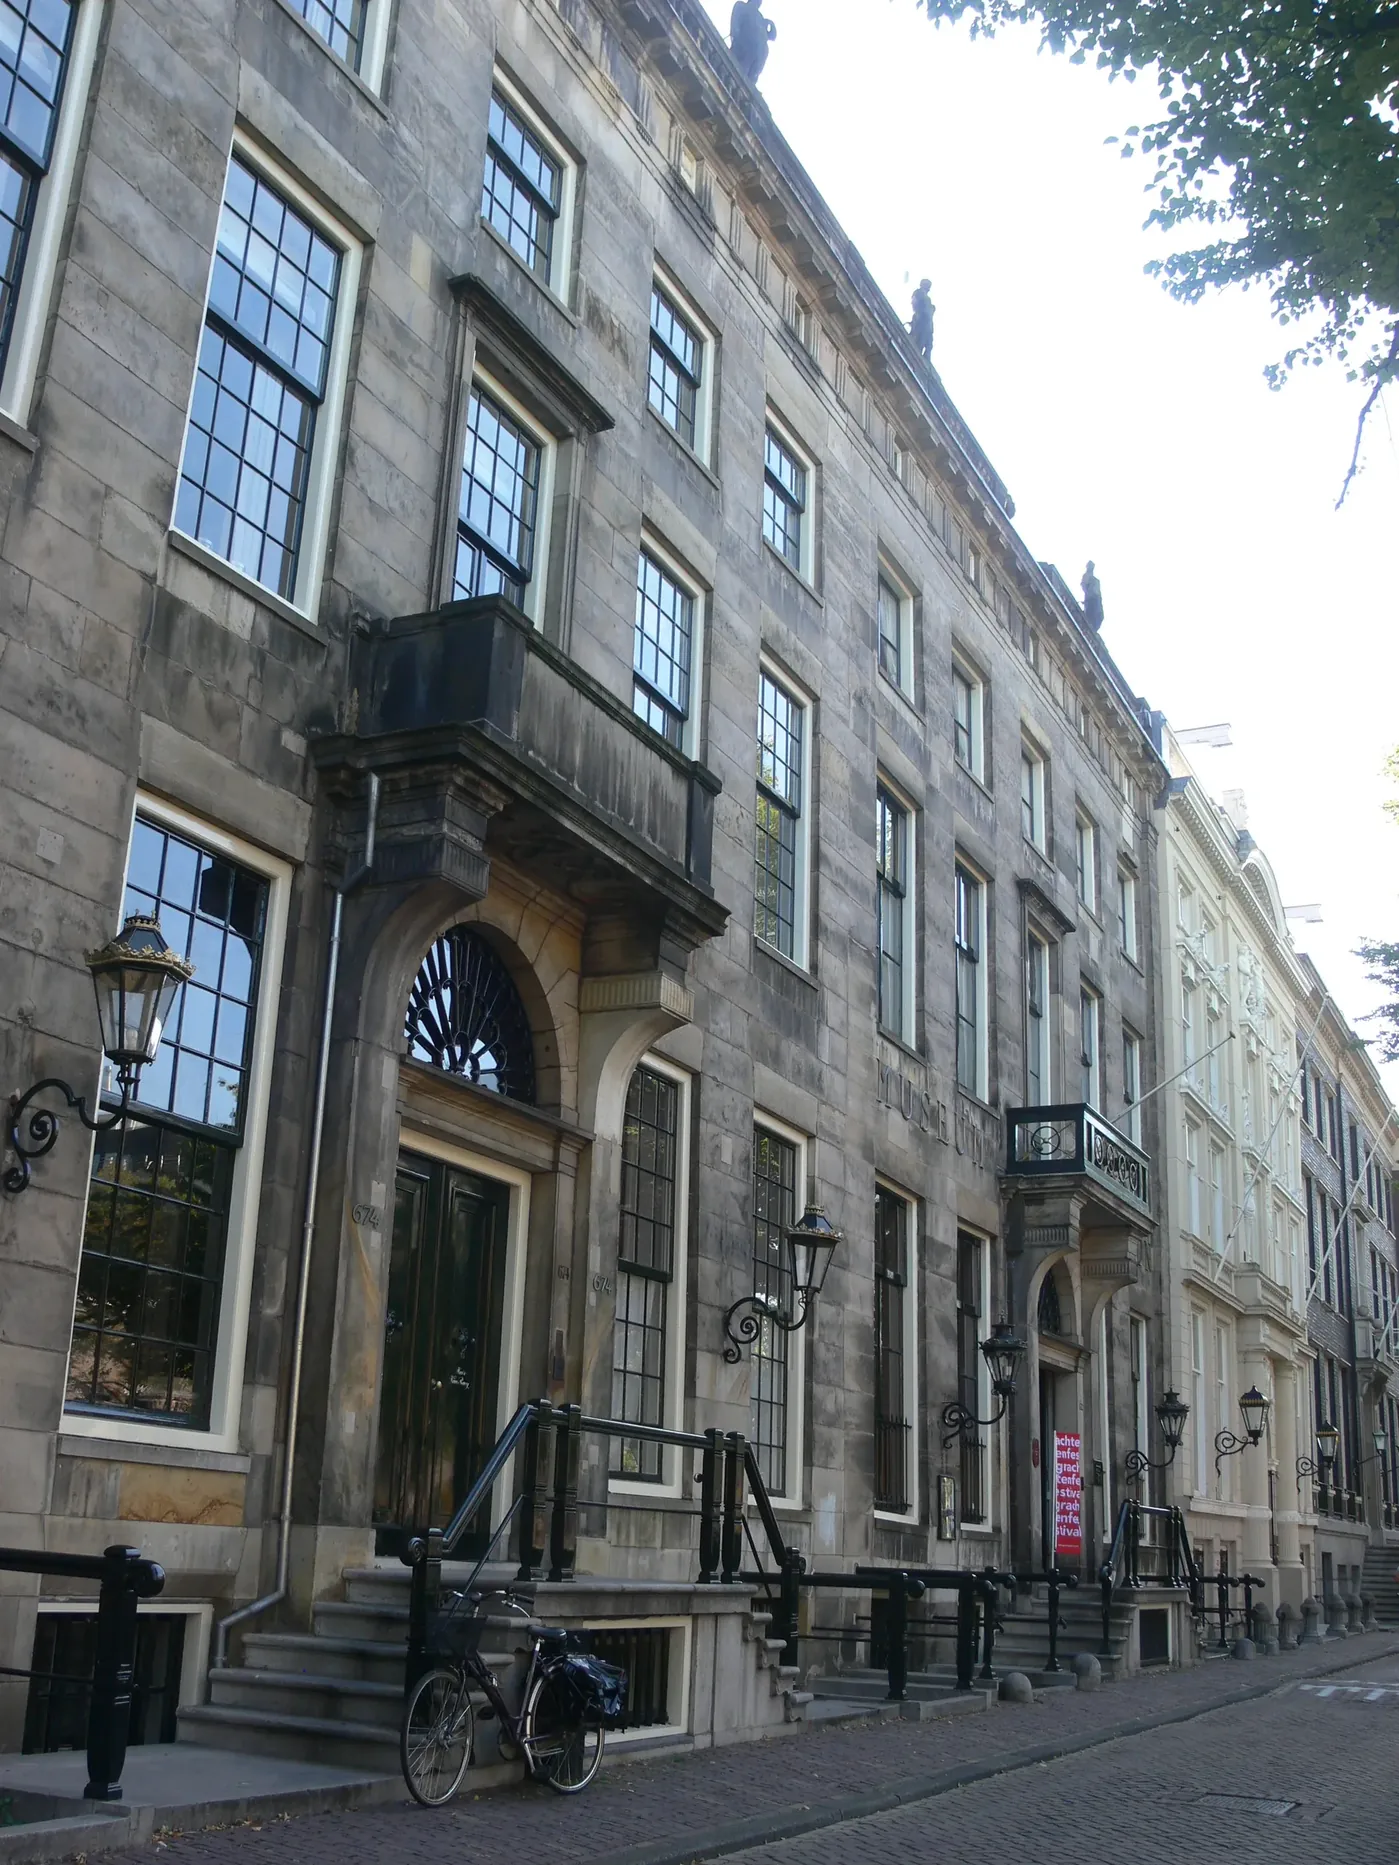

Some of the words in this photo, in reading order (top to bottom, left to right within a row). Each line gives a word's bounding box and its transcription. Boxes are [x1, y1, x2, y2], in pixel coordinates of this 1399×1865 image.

[876, 1057, 984, 1170] MUSEUM
[351, 1203, 380, 1229] 674
[592, 1272, 612, 1296] 674
